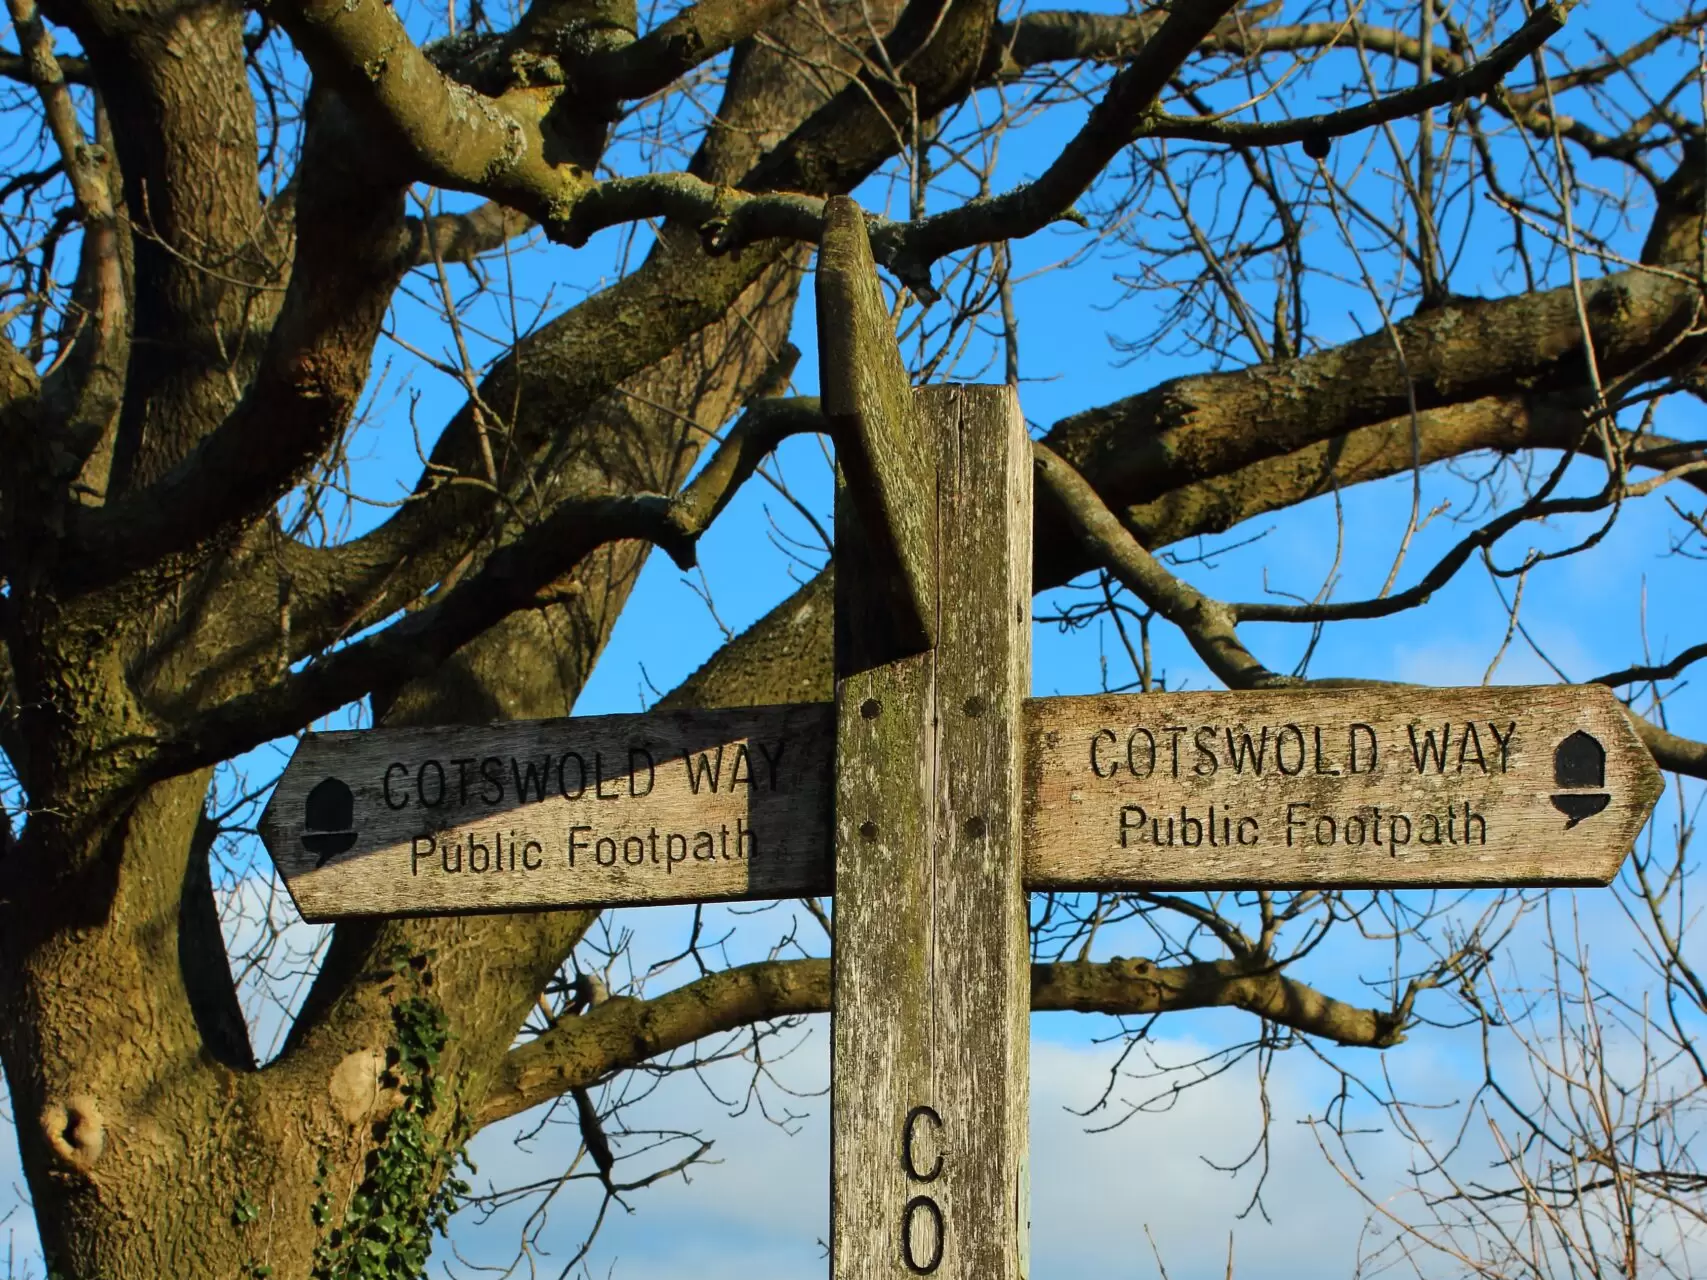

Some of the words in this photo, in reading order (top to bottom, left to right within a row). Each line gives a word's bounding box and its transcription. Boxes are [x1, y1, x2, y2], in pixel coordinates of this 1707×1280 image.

[383, 747, 656, 810] COTSWOLD
[682, 742, 785, 796] WAY
[1089, 721, 1378, 779] COTSWOLD
[1406, 720, 1518, 775] WAY
[410, 830, 544, 877] Public
[568, 819, 759, 874] Footpath
[1118, 804, 1259, 848] Public
[1286, 802, 1488, 858] Footpath
